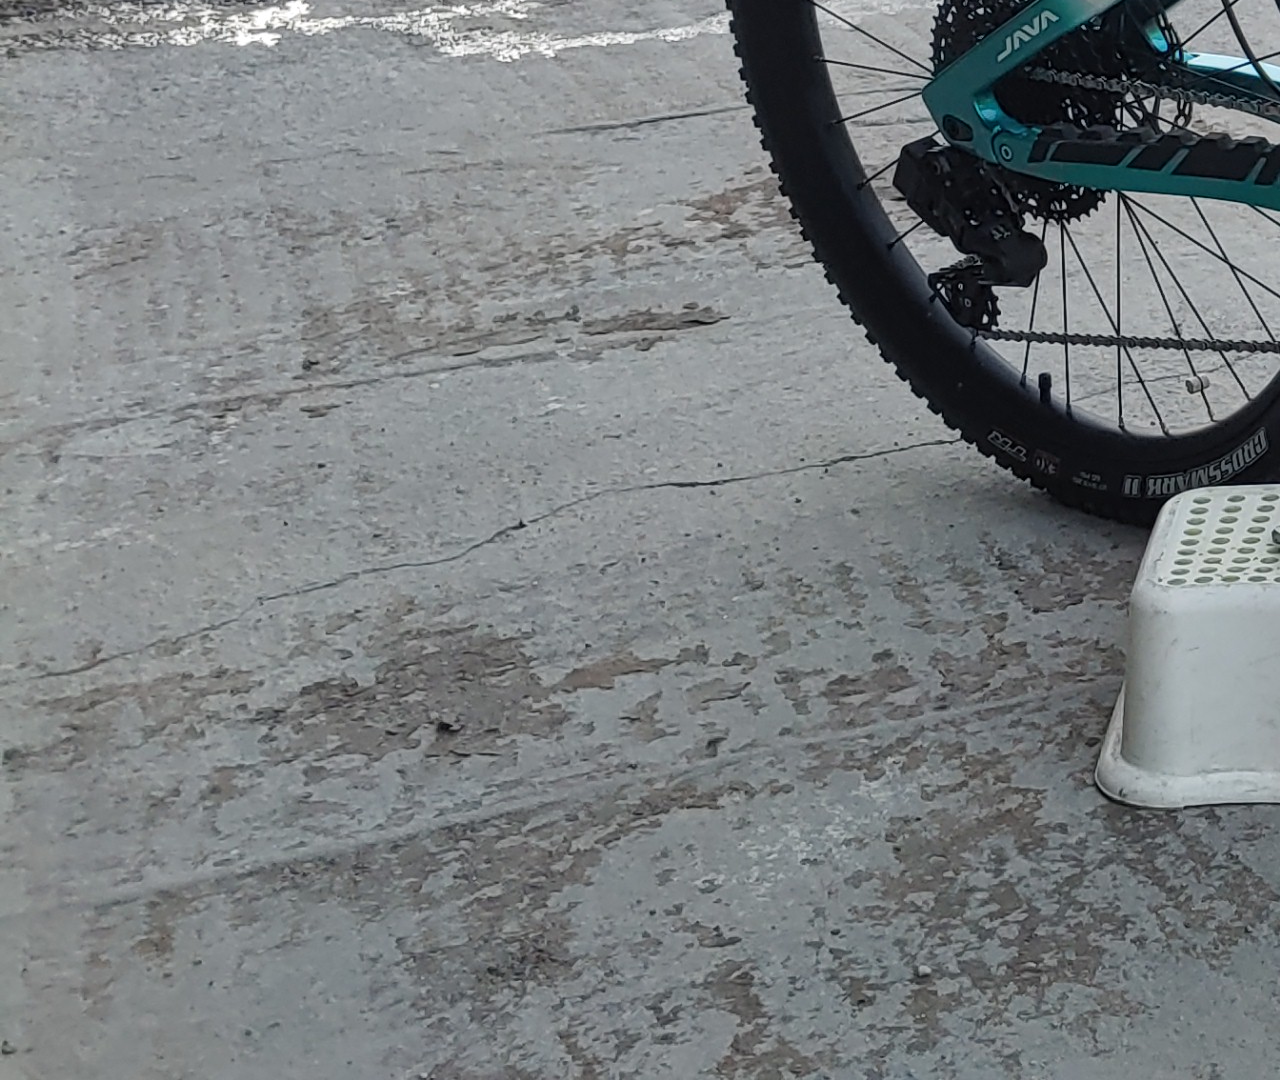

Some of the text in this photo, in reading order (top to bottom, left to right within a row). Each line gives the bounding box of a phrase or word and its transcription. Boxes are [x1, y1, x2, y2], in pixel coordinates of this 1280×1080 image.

[996, 9, 1059, 62] JAVA
[987, 430, 1028, 462] TR
[1145, 427, 1269, 498] CROSSMARK
